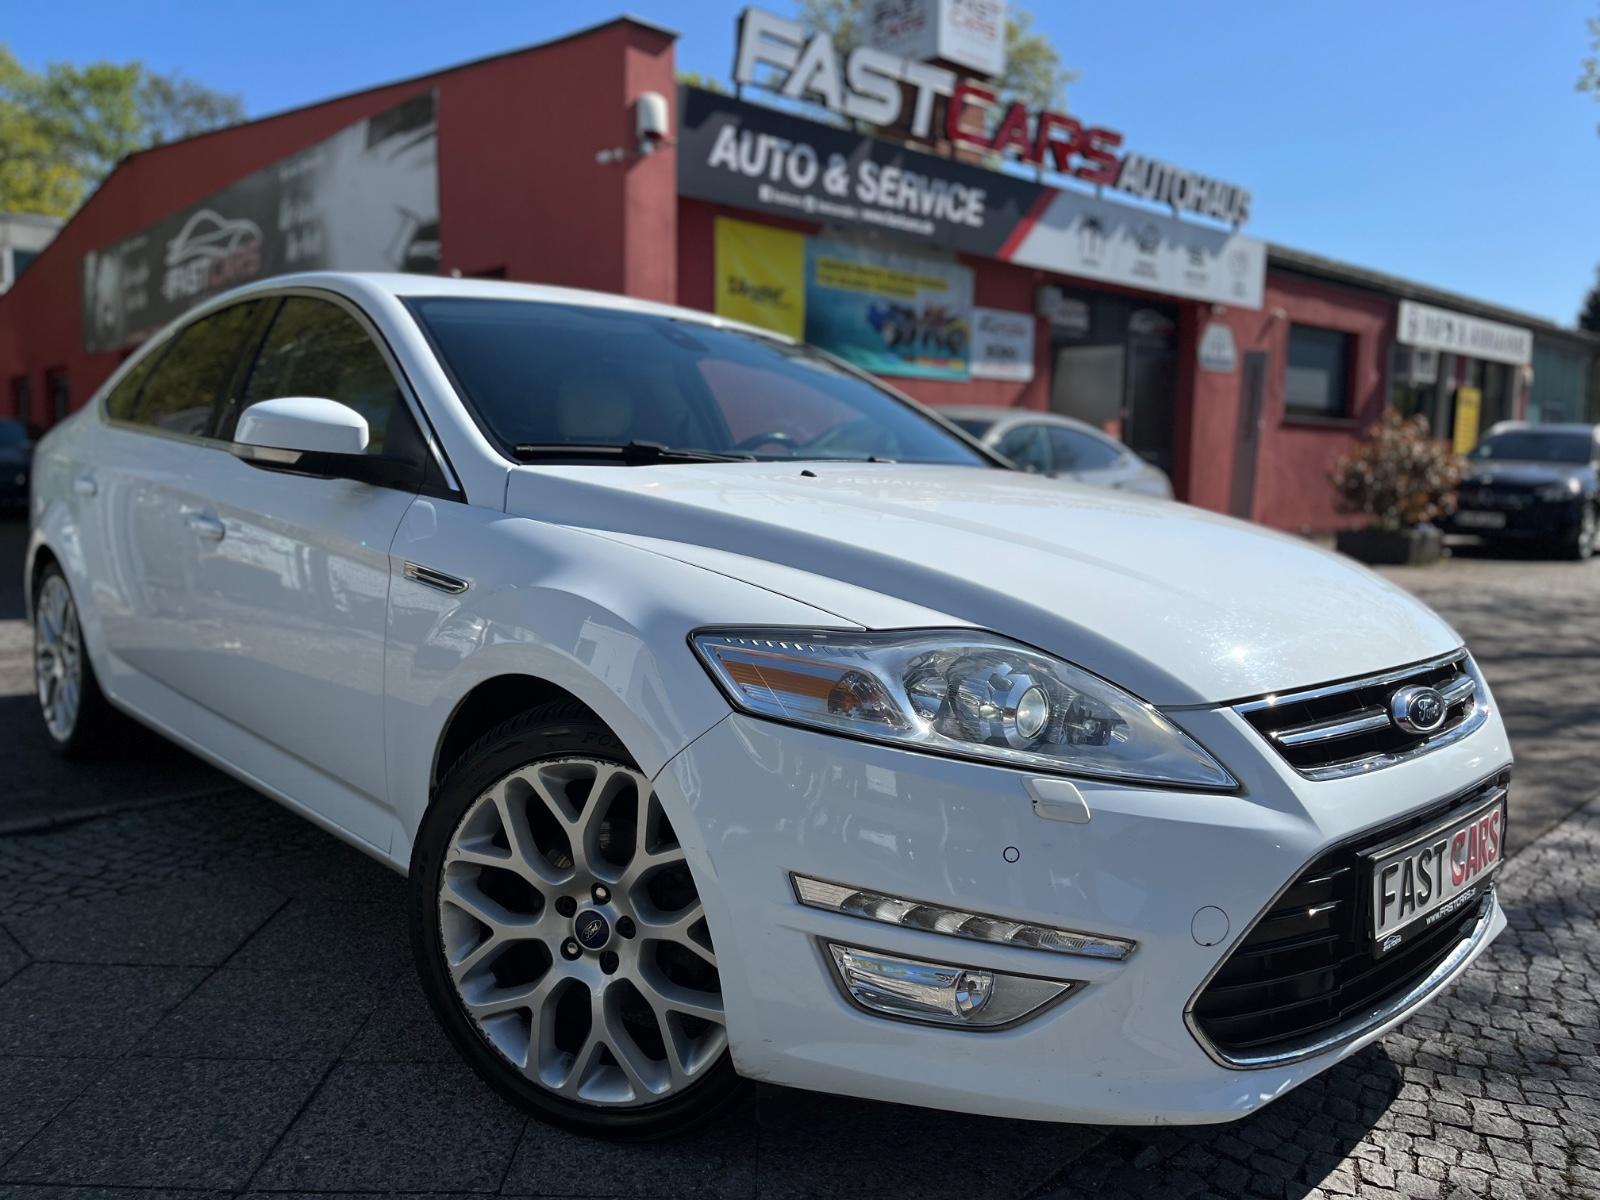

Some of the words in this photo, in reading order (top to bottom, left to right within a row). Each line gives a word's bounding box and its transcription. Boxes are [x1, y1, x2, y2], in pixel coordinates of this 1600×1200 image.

[709, 124, 818, 189] AUTO
[823, 153, 850, 198] &
[856, 160, 987, 229] SERVICE
[1117, 153, 1252, 225] AUTOHAUS
[1379, 841, 1448, 927] FAST
[1451, 809, 1500, 887] CARS
